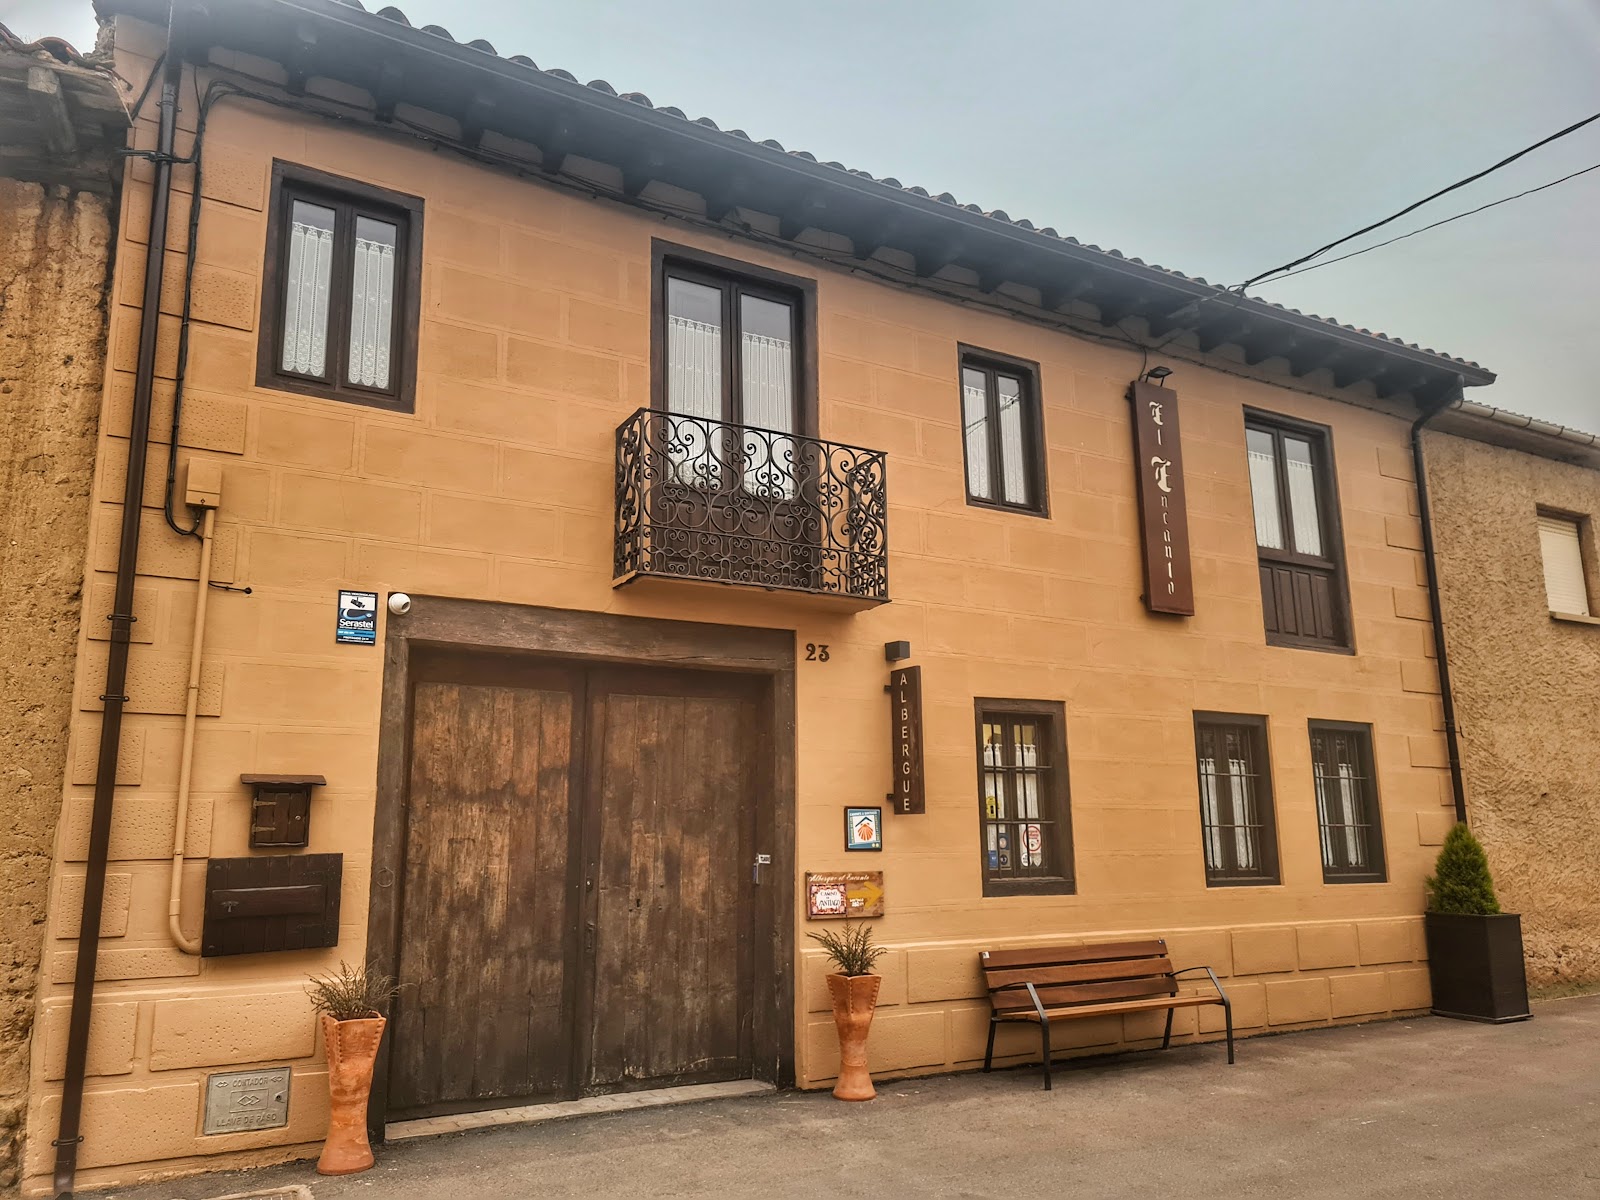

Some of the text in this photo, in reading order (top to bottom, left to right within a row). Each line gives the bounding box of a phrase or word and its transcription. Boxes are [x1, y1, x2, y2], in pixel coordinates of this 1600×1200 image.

[339, 618, 373, 628] Serastel
[805, 643, 830, 663] 23
[900, 672, 911, 811] ALBERGUE
[232, 1076, 268, 1088] CONTADOR
[216, 1113, 277, 1127] LLAVE DE PASO
